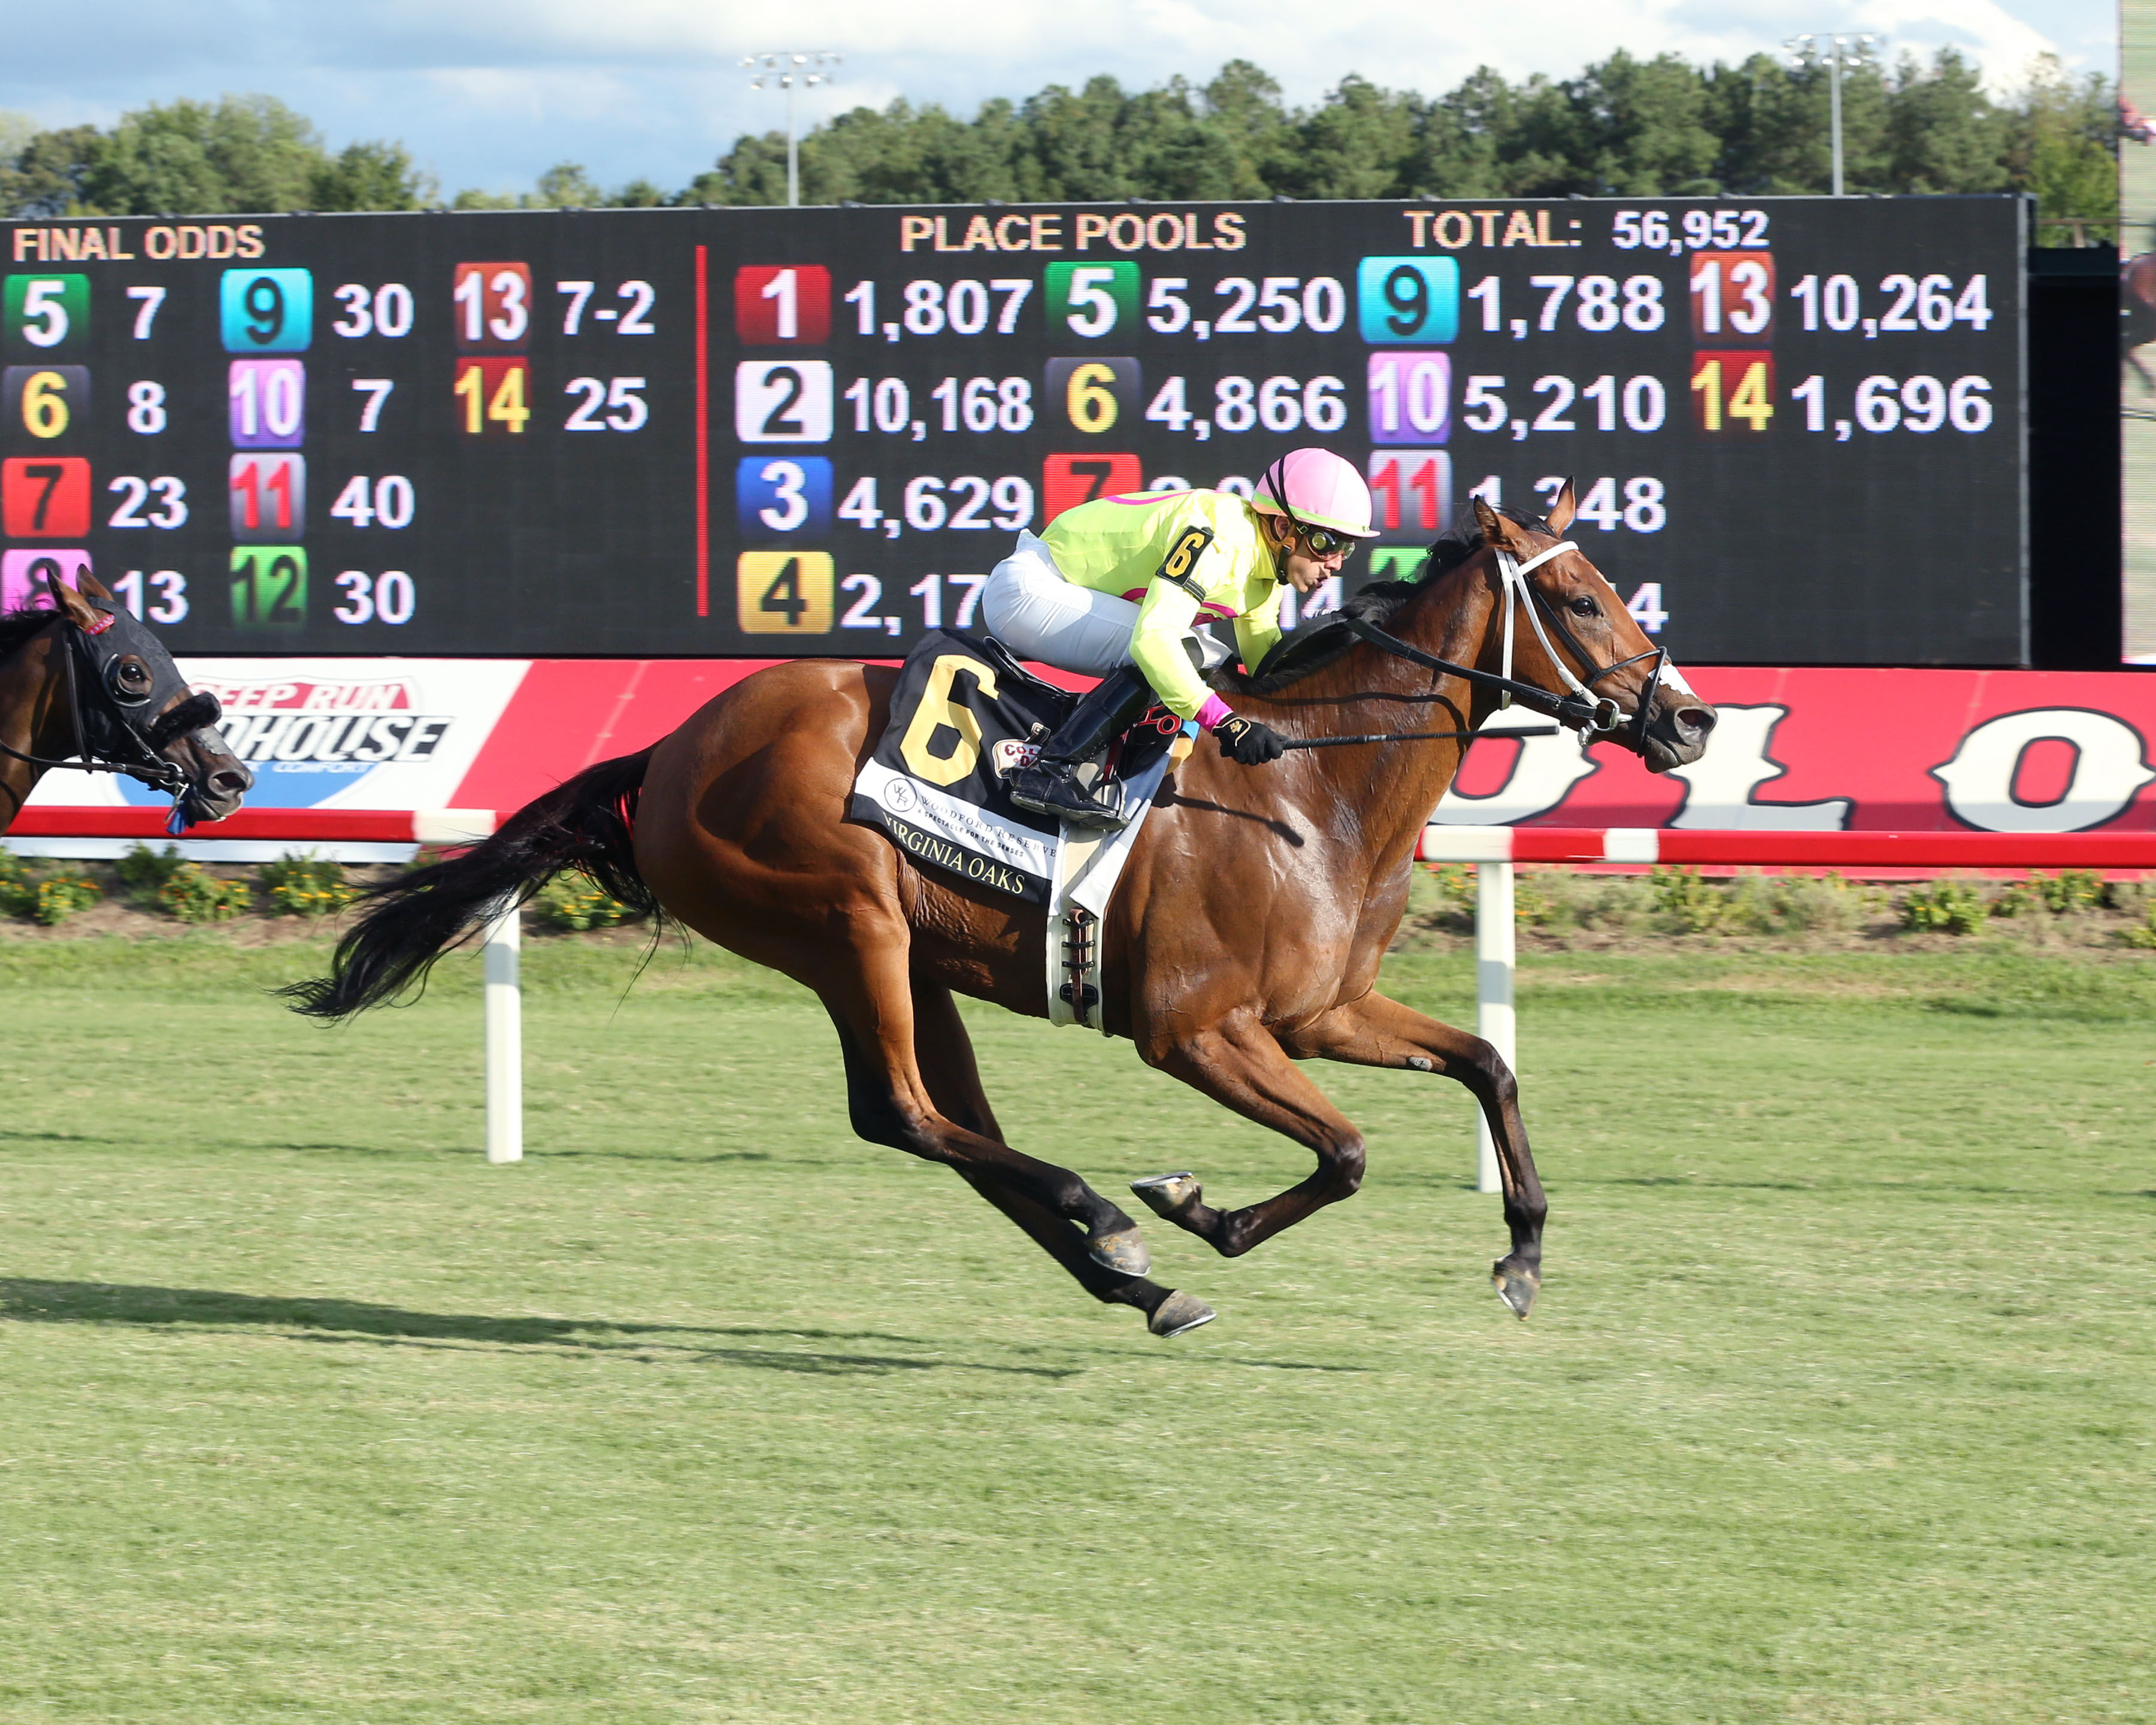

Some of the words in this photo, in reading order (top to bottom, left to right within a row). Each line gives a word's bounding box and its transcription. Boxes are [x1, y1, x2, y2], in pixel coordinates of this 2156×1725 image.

[13, 227, 135, 262] FINAL
[145, 225, 265, 259] ODDS
[901, 214, 1062, 252] PLACE
[1076, 213, 1246, 252] POOLS
[1403, 210, 1582, 249] TOTAL:
[1612, 210, 1769, 256] 56,952
[23, 280, 68, 347] 5
[126, 286, 166, 340] 7
[246, 278, 283, 345] 9
[332, 283, 414, 338] 30
[454, 271, 528, 341] 13
[556, 280, 655, 335] 7-2
[762, 269, 797, 338] 1
[844, 279, 1034, 343] 1,807
[1067, 268, 1118, 337] 5
[1147, 277, 1346, 341] 5,250
[1385, 265, 1428, 335] 9
[1468, 275, 1666, 340] 1,788
[1690, 261, 1771, 334] 13
[1791, 274, 1993, 338] 10,264
[22, 371, 68, 438] 6
[127, 380, 166, 434] 8
[230, 368, 304, 437] 10
[352, 379, 393, 432] 7
[455, 366, 529, 434] 14
[564, 377, 648, 431] 25
[762, 367, 803, 434] 2
[844, 377, 1034, 442] 10,168
[1067, 364, 1118, 433] 6
[1145, 376, 1348, 441] 4,866
[1369, 361, 1450, 433] 10
[1464, 375, 1666, 441] 5,210
[1691, 359, 1774, 431] 14
[1791, 375, 1993, 442] 1,696
[25, 465, 63, 530] 7
[108, 476, 189, 529] 23
[230, 462, 292, 528] 11
[330, 475, 415, 529] 40
[759, 460, 808, 531] 3
[838, 476, 1035, 539] 4,629
[1368, 458, 1439, 529] 11
[1165, 532, 1205, 578] 6
[27, 557, 62, 610] 8
[113, 570, 190, 624] 13
[231, 555, 301, 624] 12
[334, 570, 416, 625] 30
[760, 557, 807, 626] 4
[841, 573, 990, 637] 2,17
[302, 683, 404, 710] RUN
[900, 654, 1000, 787] 6
[882, 810, 964, 872] VIRGINIA
[968, 857, 1026, 895] OAKS
[920, 795, 994, 833] WOODFORD
[997, 826, 1057, 858] RESERVE
[924, 811, 964, 833] SPECTACLE
[965, 829, 979, 839] FOR
[981, 836, 995, 846] THE
[997, 842, 1025, 858] SENSES
